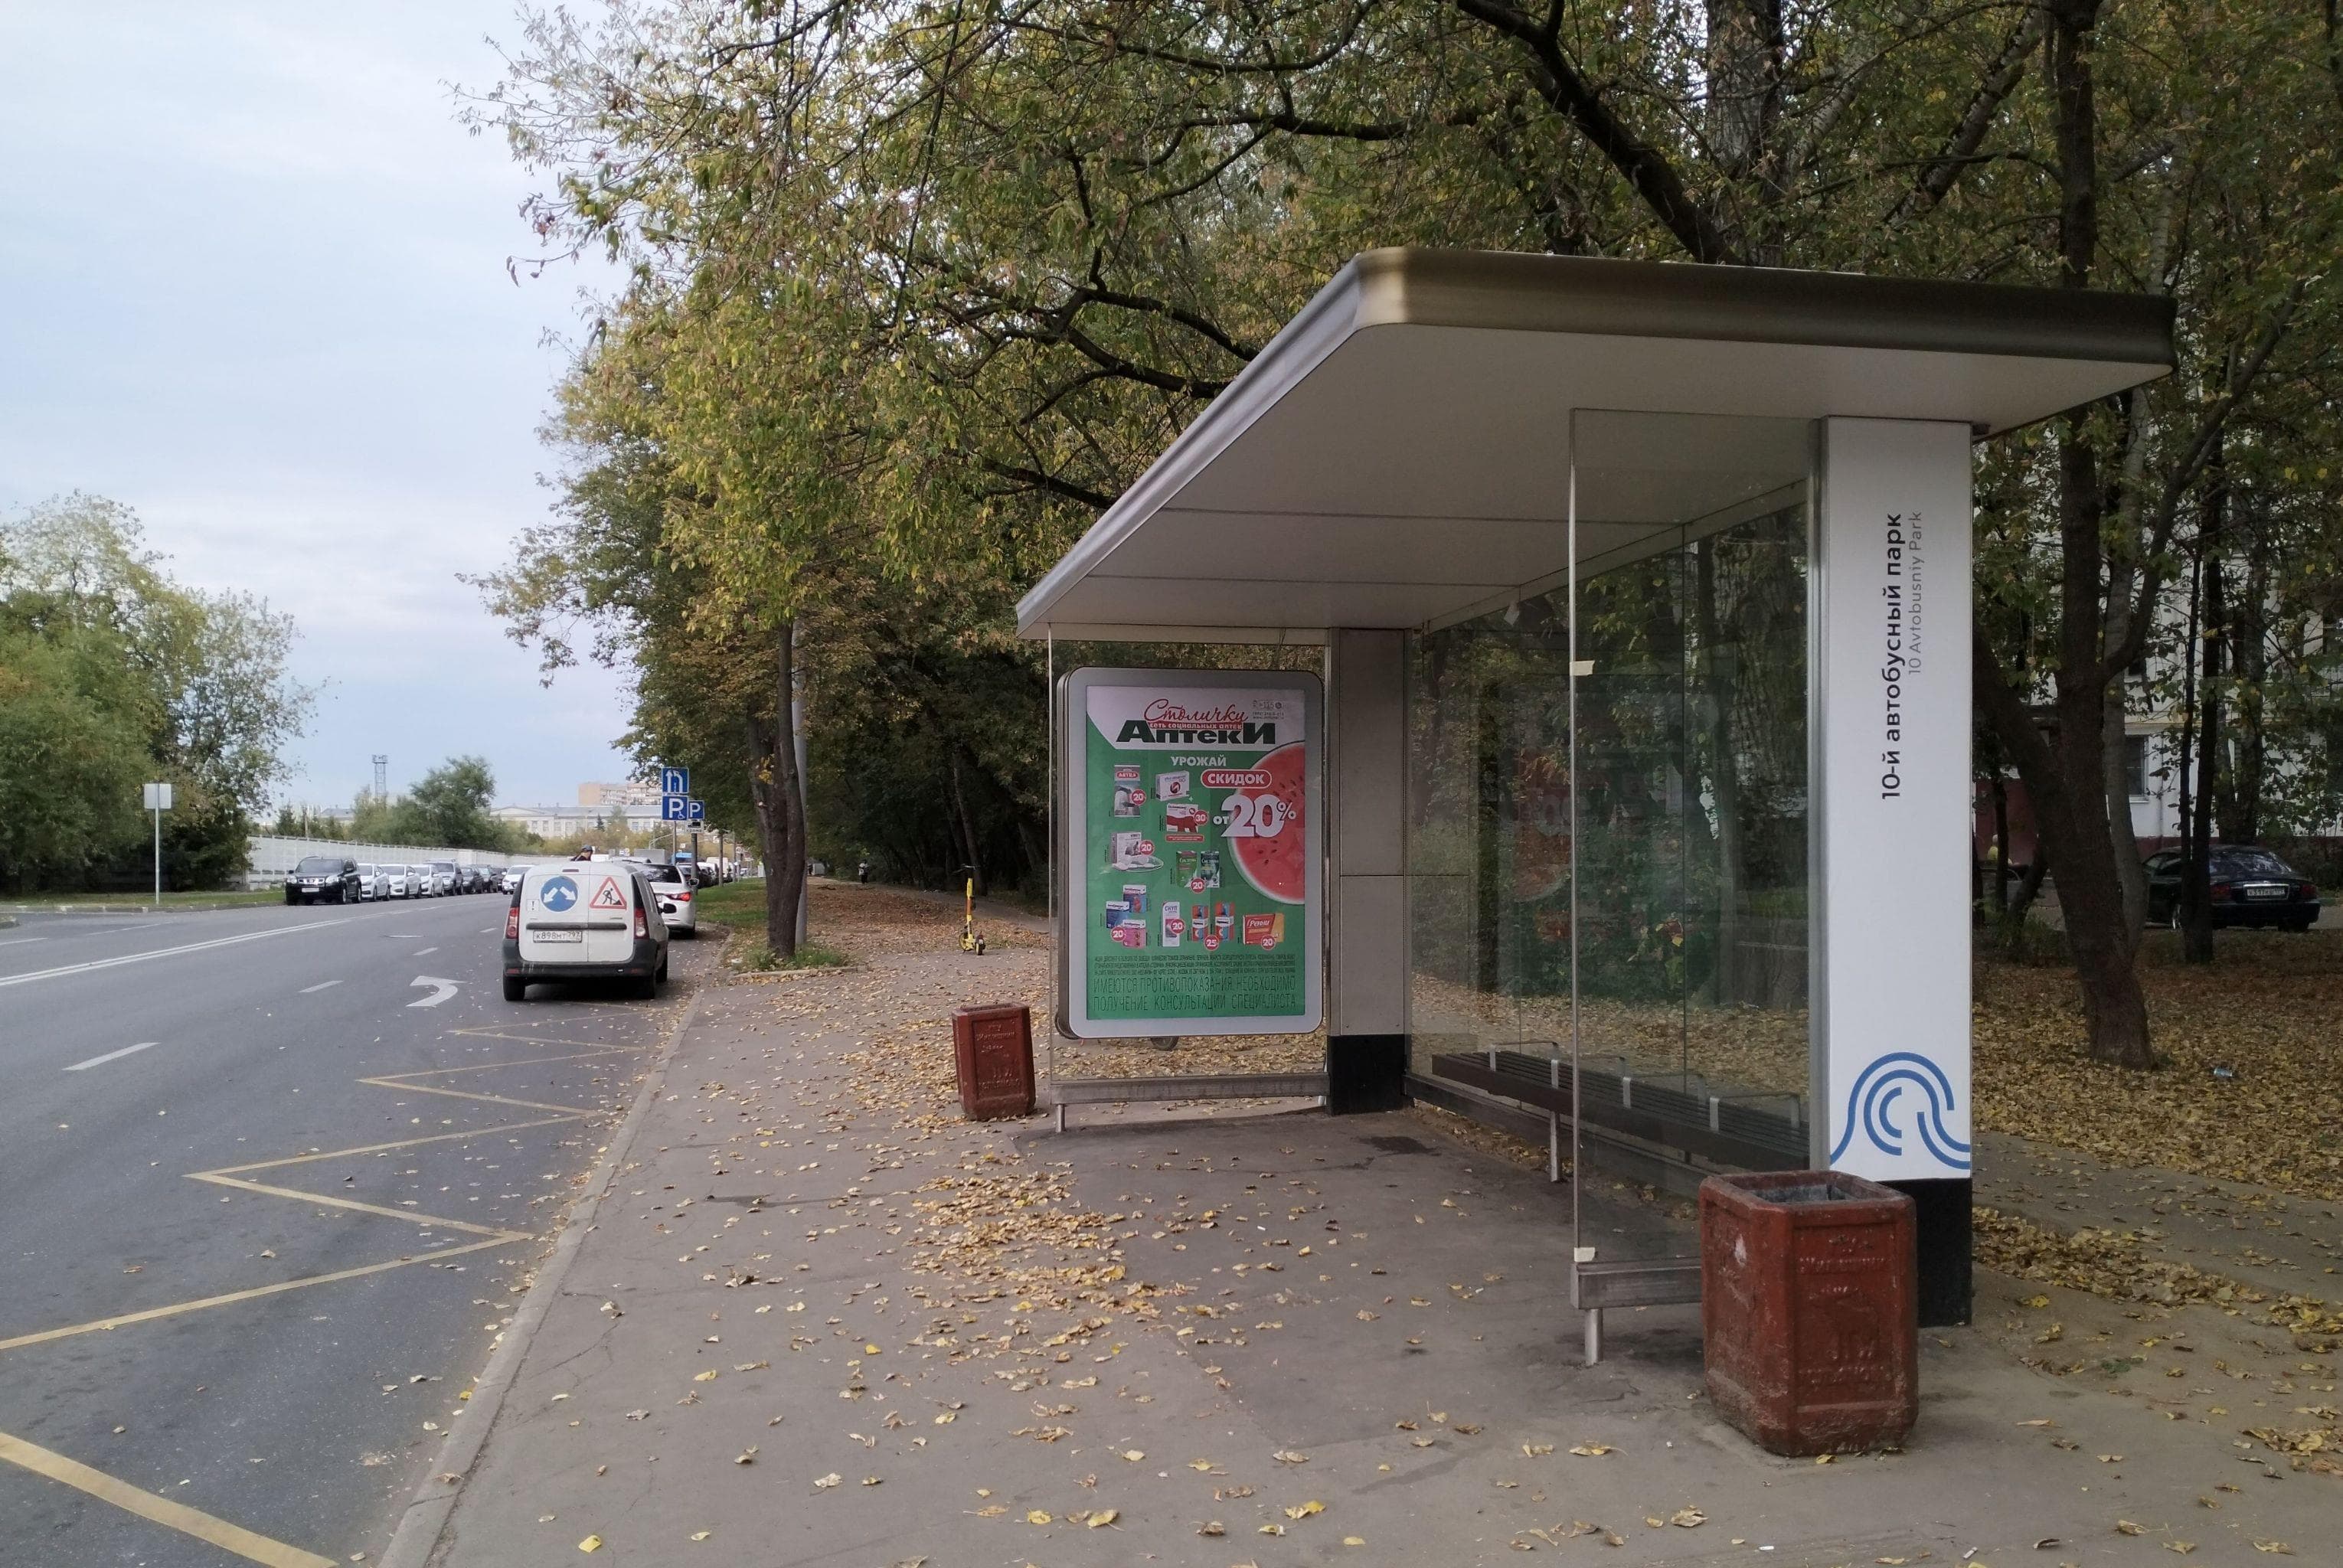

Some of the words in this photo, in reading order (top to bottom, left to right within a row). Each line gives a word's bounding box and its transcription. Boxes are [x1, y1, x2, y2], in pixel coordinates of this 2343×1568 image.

[1908, 511, 1922, 550] Park
[1887, 513, 1906, 576] парк
[1908, 555, 1925, 654] Avtobusniy
[1881, 584, 1905, 742] автобусный
[1909, 658, 1922, 675] 10
[1143, 698, 1249, 722] Столички
[1170, 753, 1227, 766] УРОЖАЙ
[1207, 772, 1265, 786] СКИДОК
[1881, 750, 1901, 800] 10-й
[668, 798, 684, 818] P
[689, 802, 701, 818] P
[1141, 843, 1152, 851] 20
[1192, 881, 1203, 890] 20
[1172, 922, 1183, 930] 20
[1206, 939, 1217, 947] 25
[1093, 977, 1137, 993] ИМЕЮТСЯ
[1237, 975, 1296, 991] НЕОБХОДИМО
[1093, 995, 1149, 1011] ПОЛУЧЕНИЕ
[1155, 995, 1226, 1011] КОНСУЛЬТАЦИИ
[1231, 993, 1296, 1010] СПЕЦИАЛИСТА
